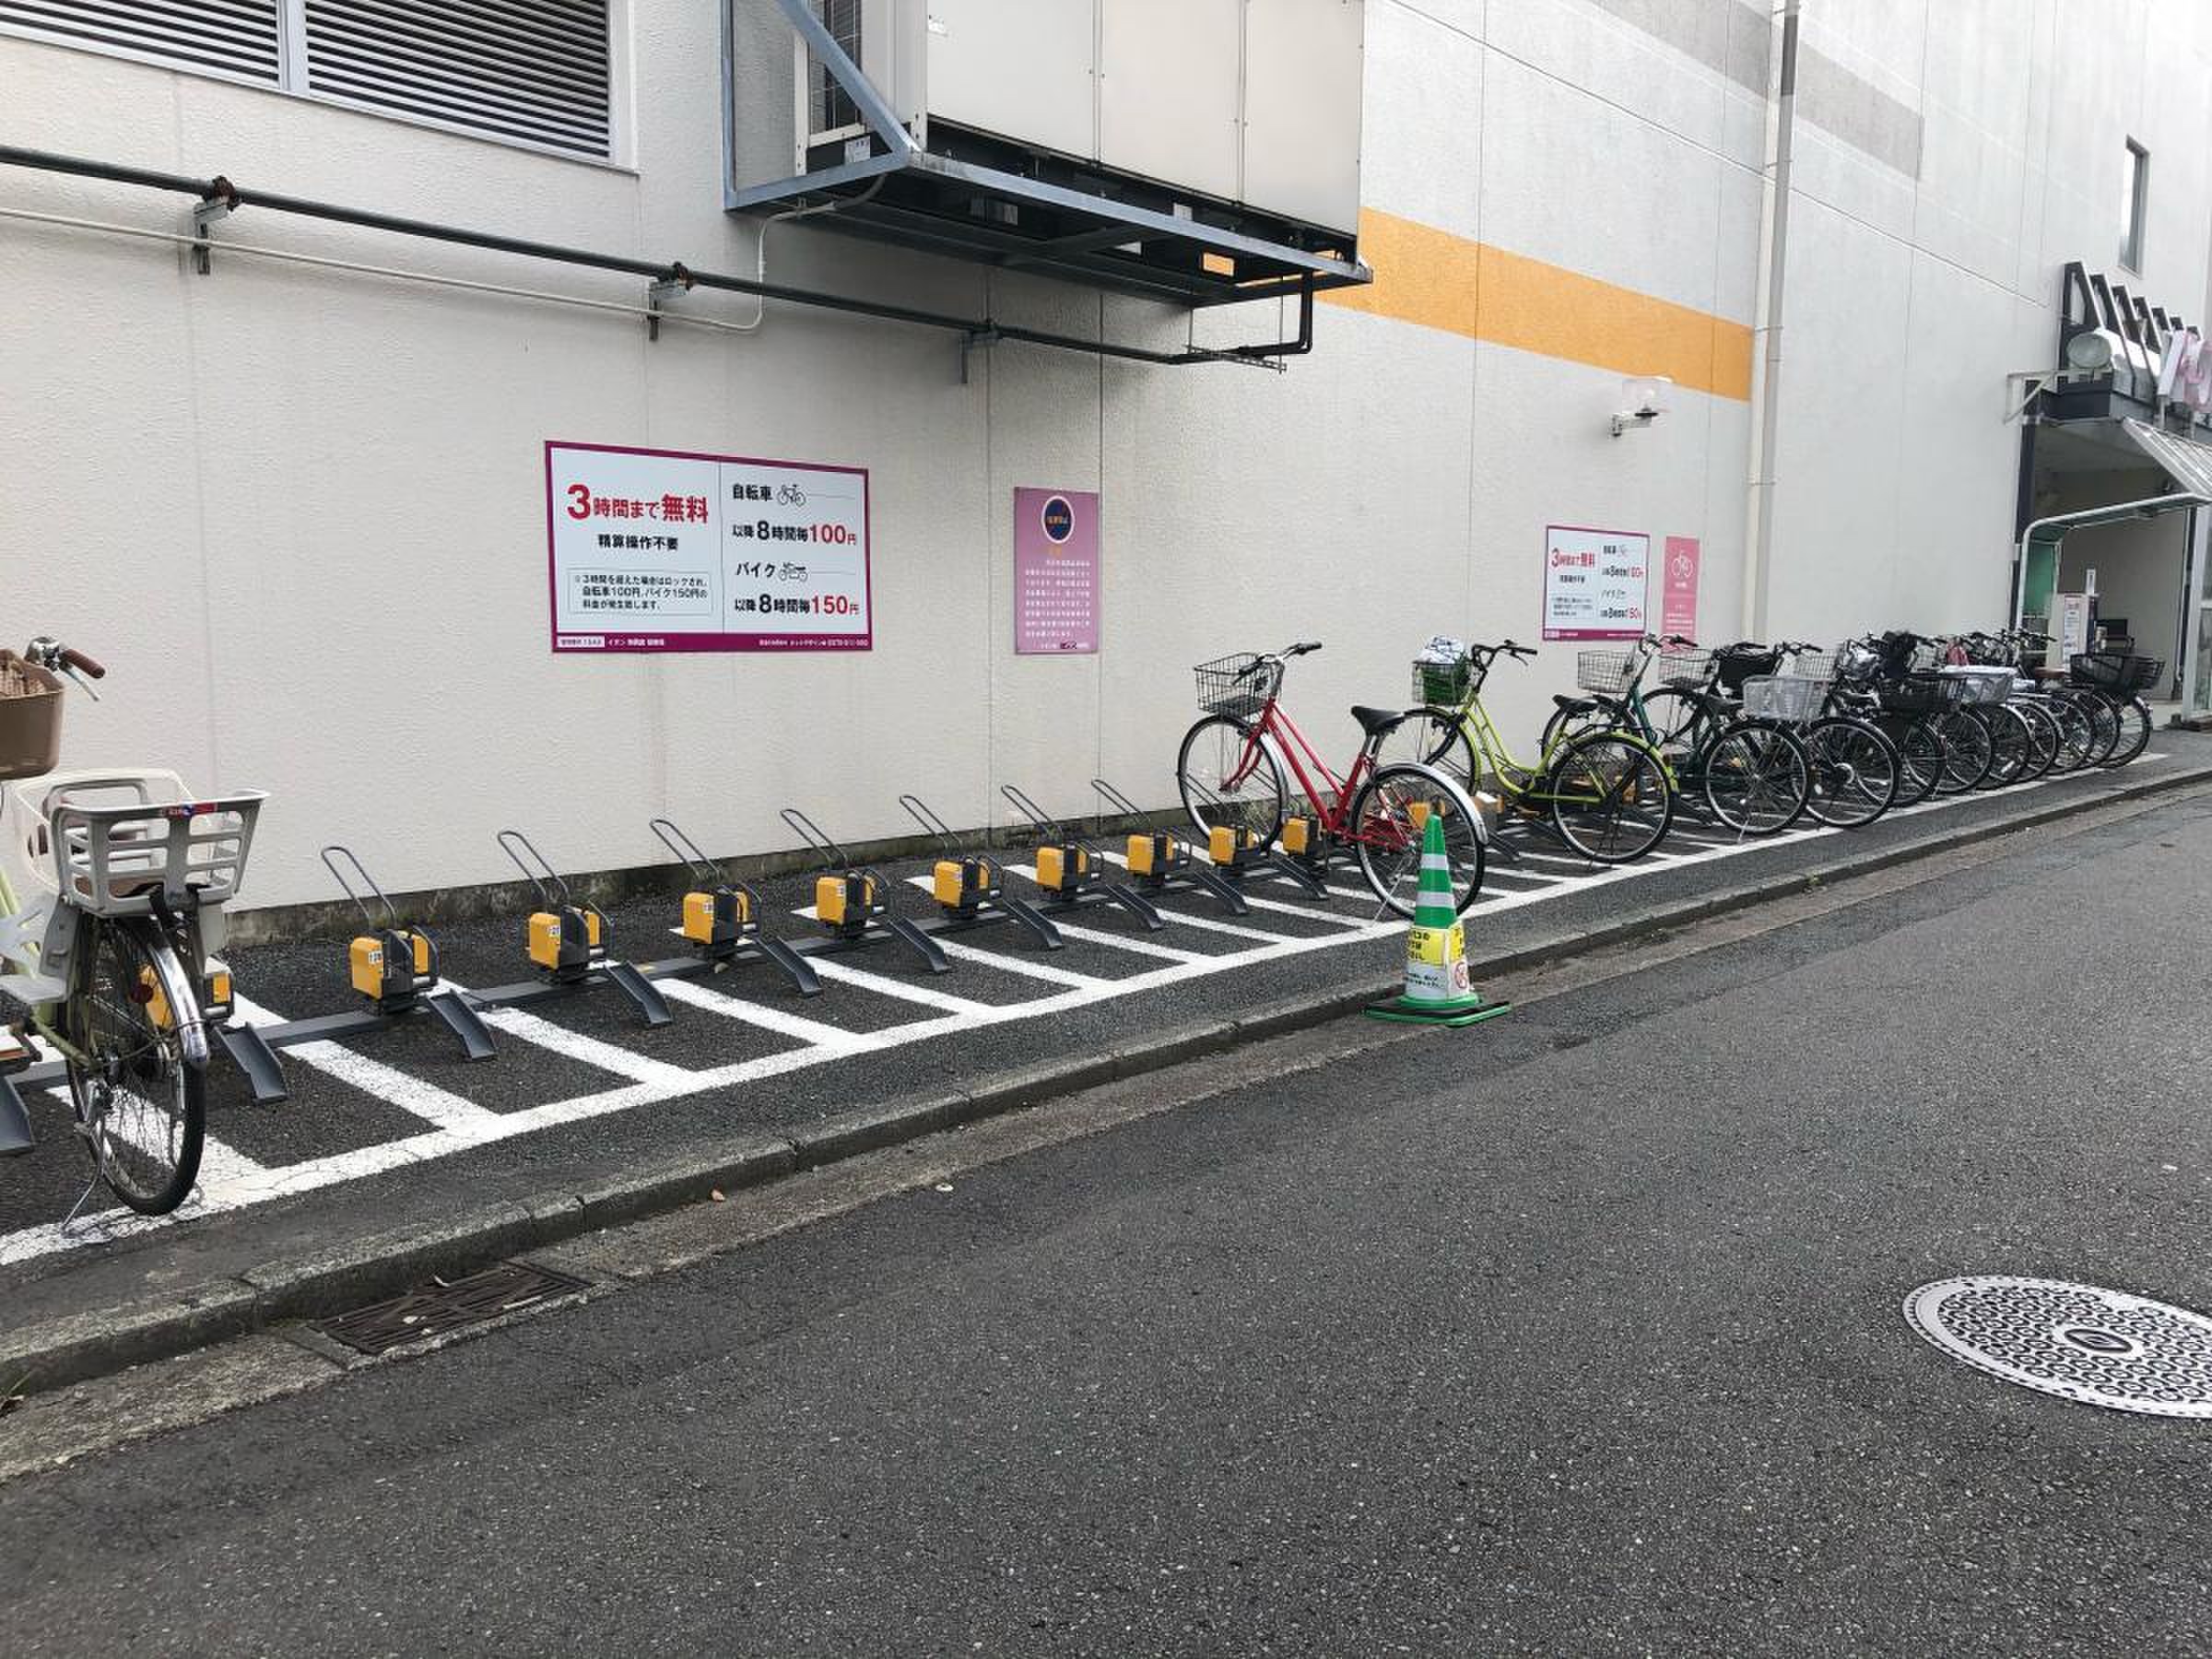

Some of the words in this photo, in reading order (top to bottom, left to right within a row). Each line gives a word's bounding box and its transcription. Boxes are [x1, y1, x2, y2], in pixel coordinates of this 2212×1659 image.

[733, 483, 773, 501] 自転車
[567, 484, 708, 524] 3時間まで無料
[598, 534, 678, 550] 精算操作不要
[735, 561, 776, 578] バイク
